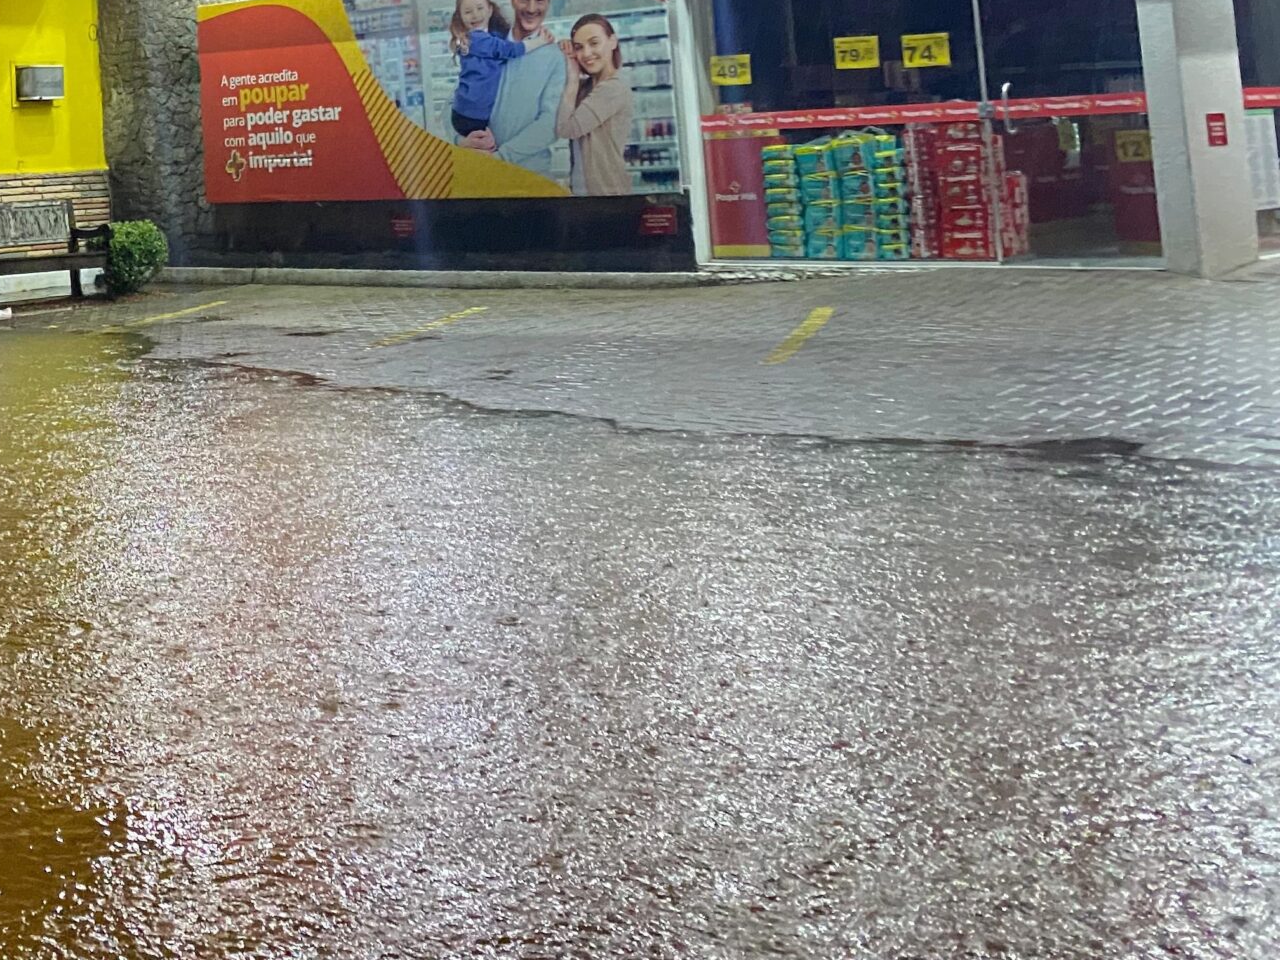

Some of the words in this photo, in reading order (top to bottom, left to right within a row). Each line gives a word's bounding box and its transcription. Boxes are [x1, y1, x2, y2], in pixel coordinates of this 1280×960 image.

[220, 74, 229, 87] A
[229, 74, 256, 90] gente
[258, 69, 298, 84] acredita
[222, 96, 238, 106] em
[239, 83, 310, 112] poupar
[223, 117, 245, 130] para
[246, 107, 291, 131] poder
[292, 106, 341, 127] gastar
[224, 137, 245, 147] com
[248, 126, 293, 150] aquilo
[295, 132, 316, 148] que
